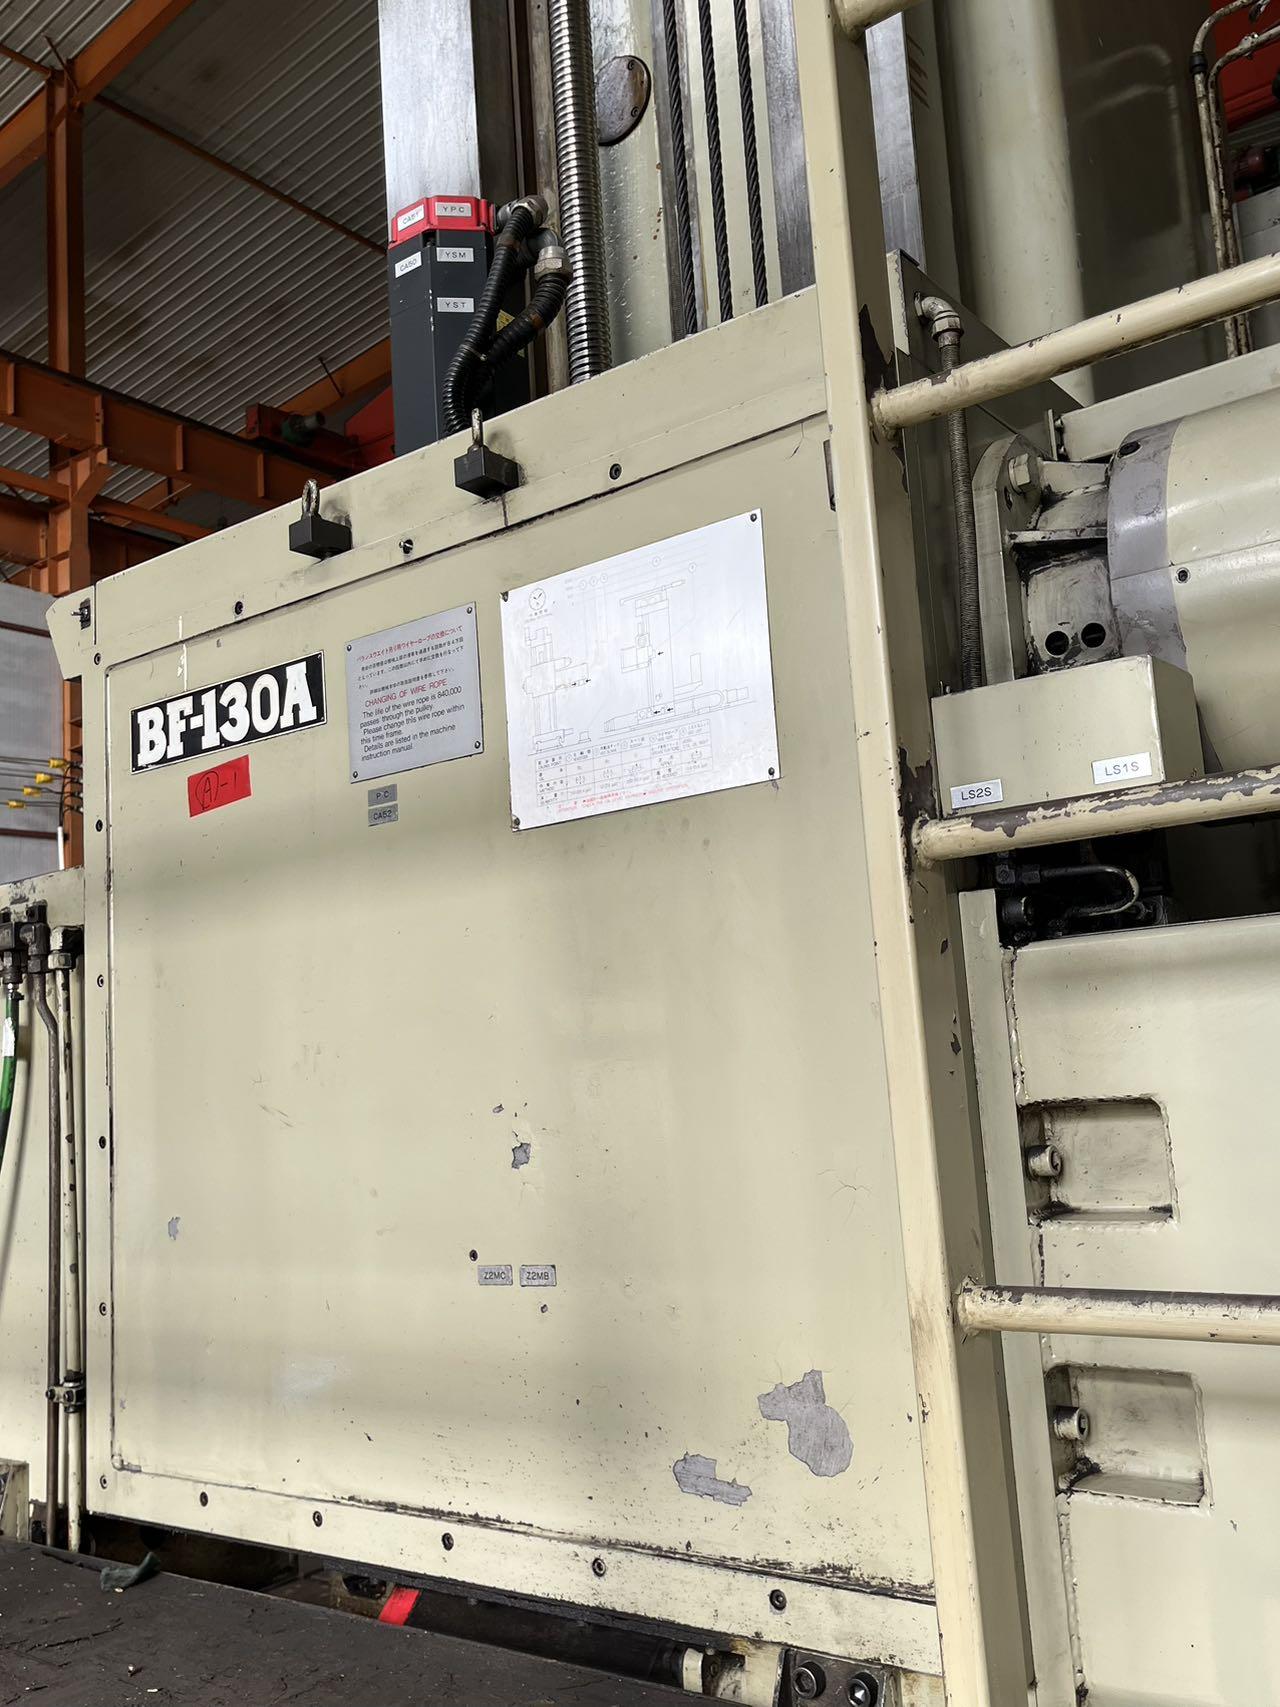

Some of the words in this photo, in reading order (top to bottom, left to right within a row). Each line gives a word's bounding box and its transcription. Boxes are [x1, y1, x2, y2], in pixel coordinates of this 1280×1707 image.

[445, 251, 467, 259] YSM
[364, 693, 397, 708] CHANGING
[400, 690, 408, 699] OF
[410, 684, 427, 695] WIRE
[429, 678, 448, 690] ROPE
[363, 710, 374, 719] The
[375, 706, 384, 716] life
[385, 704, 391, 713] of
[392, 701, 401, 711] the
[402, 699, 415, 709] wire
[416, 695, 430, 706] rope
[431, 693, 436, 701] is
[437, 686, 462, 700] 840,000
[137, 661, 317, 767] BF-130A
[360, 718, 379, 730] passes
[381, 711, 404, 724] through
[404, 707, 414, 717] the
[363, 725, 382, 735] Please
[383, 720, 405, 731] change
[405, 715, 417, 725] this
[417, 712, 431, 722] wire
[431, 708, 445, 719] rope
[446, 703, 465, 714] within
[360, 736, 371, 745] this
[372, 733, 384, 743] time
[363, 742, 384, 753] Details
[384, 738, 394, 746] are
[395, 735, 411, 745] listed
[419, 730, 429, 739] the
[430, 723, 456, 736] machine
[361, 747, 391, 761] instruction
[1104, 761, 1140, 777] LS1S
[960, 786, 993, 801] LS2S
[483, 1271, 507, 1280] Z2MC
[526, 1271, 550, 1281] Z2MB
